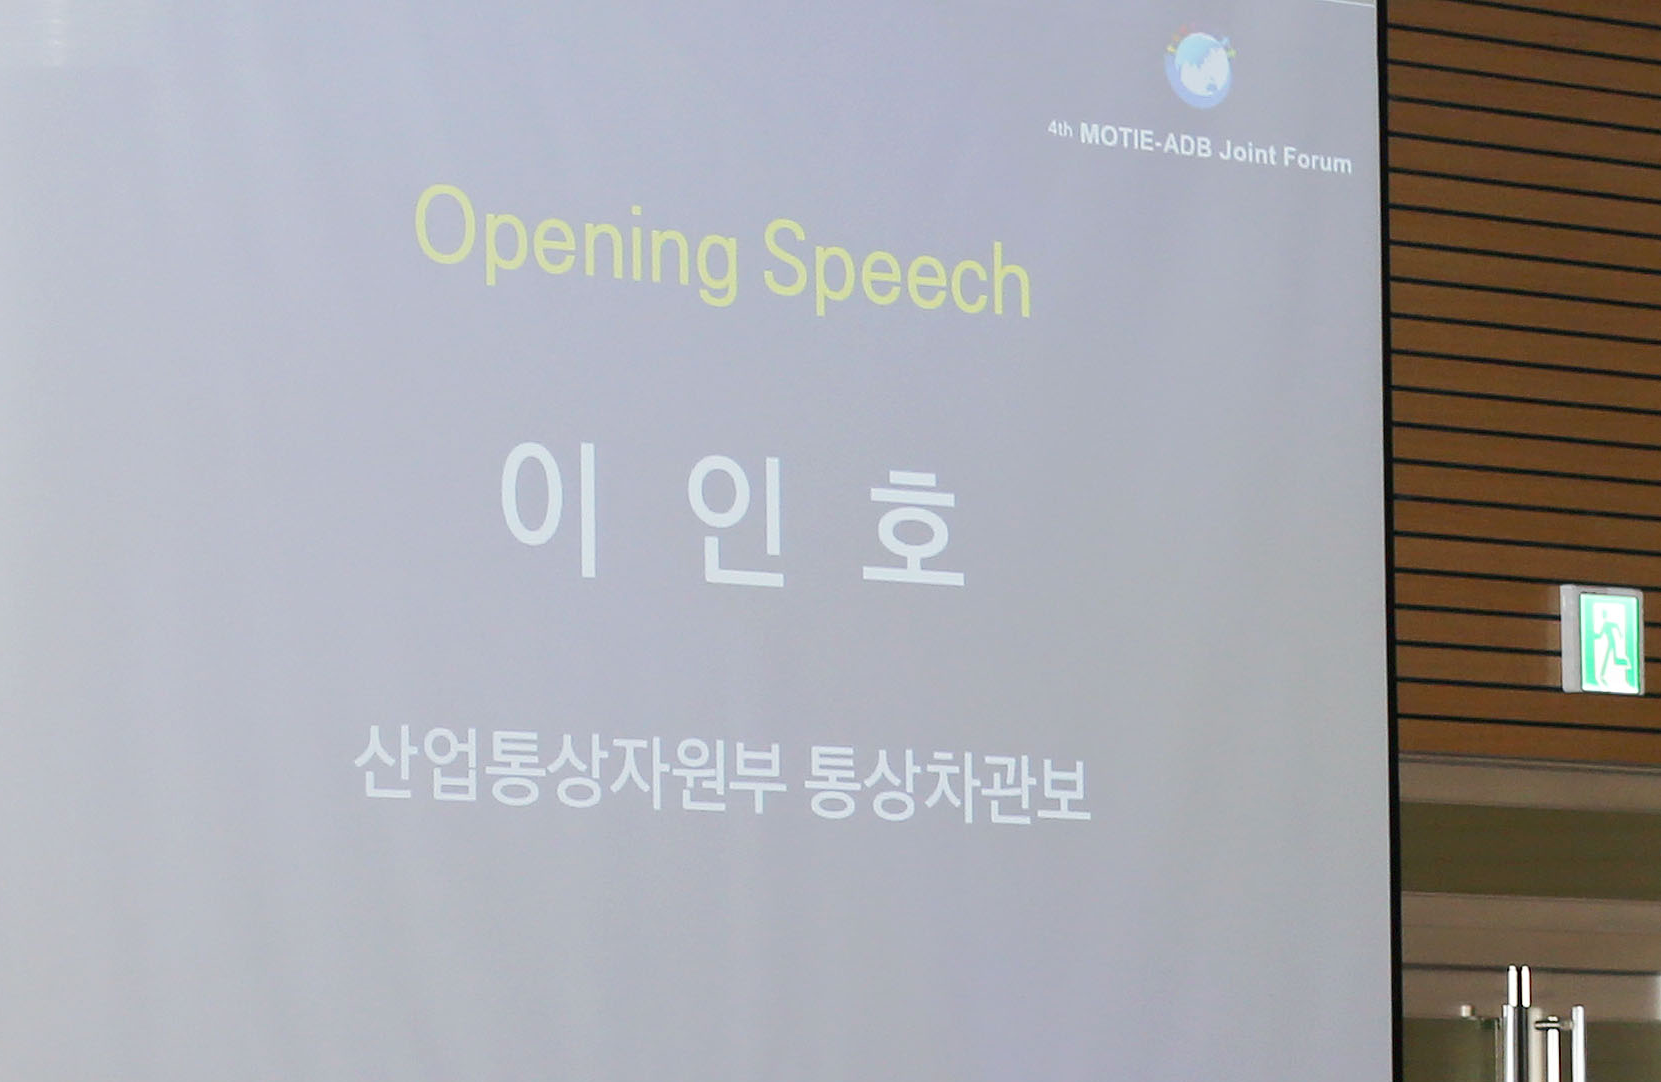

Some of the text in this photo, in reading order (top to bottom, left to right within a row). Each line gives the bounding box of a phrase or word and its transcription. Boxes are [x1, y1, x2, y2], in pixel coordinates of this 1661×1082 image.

[1048, 120, 1351, 174] 4th MOTIE-ADB Joint Forum
[416, 185, 1029, 317] Opening Speech
[354, 724, 1091, 824] 산업통상자원부 통상차관보
